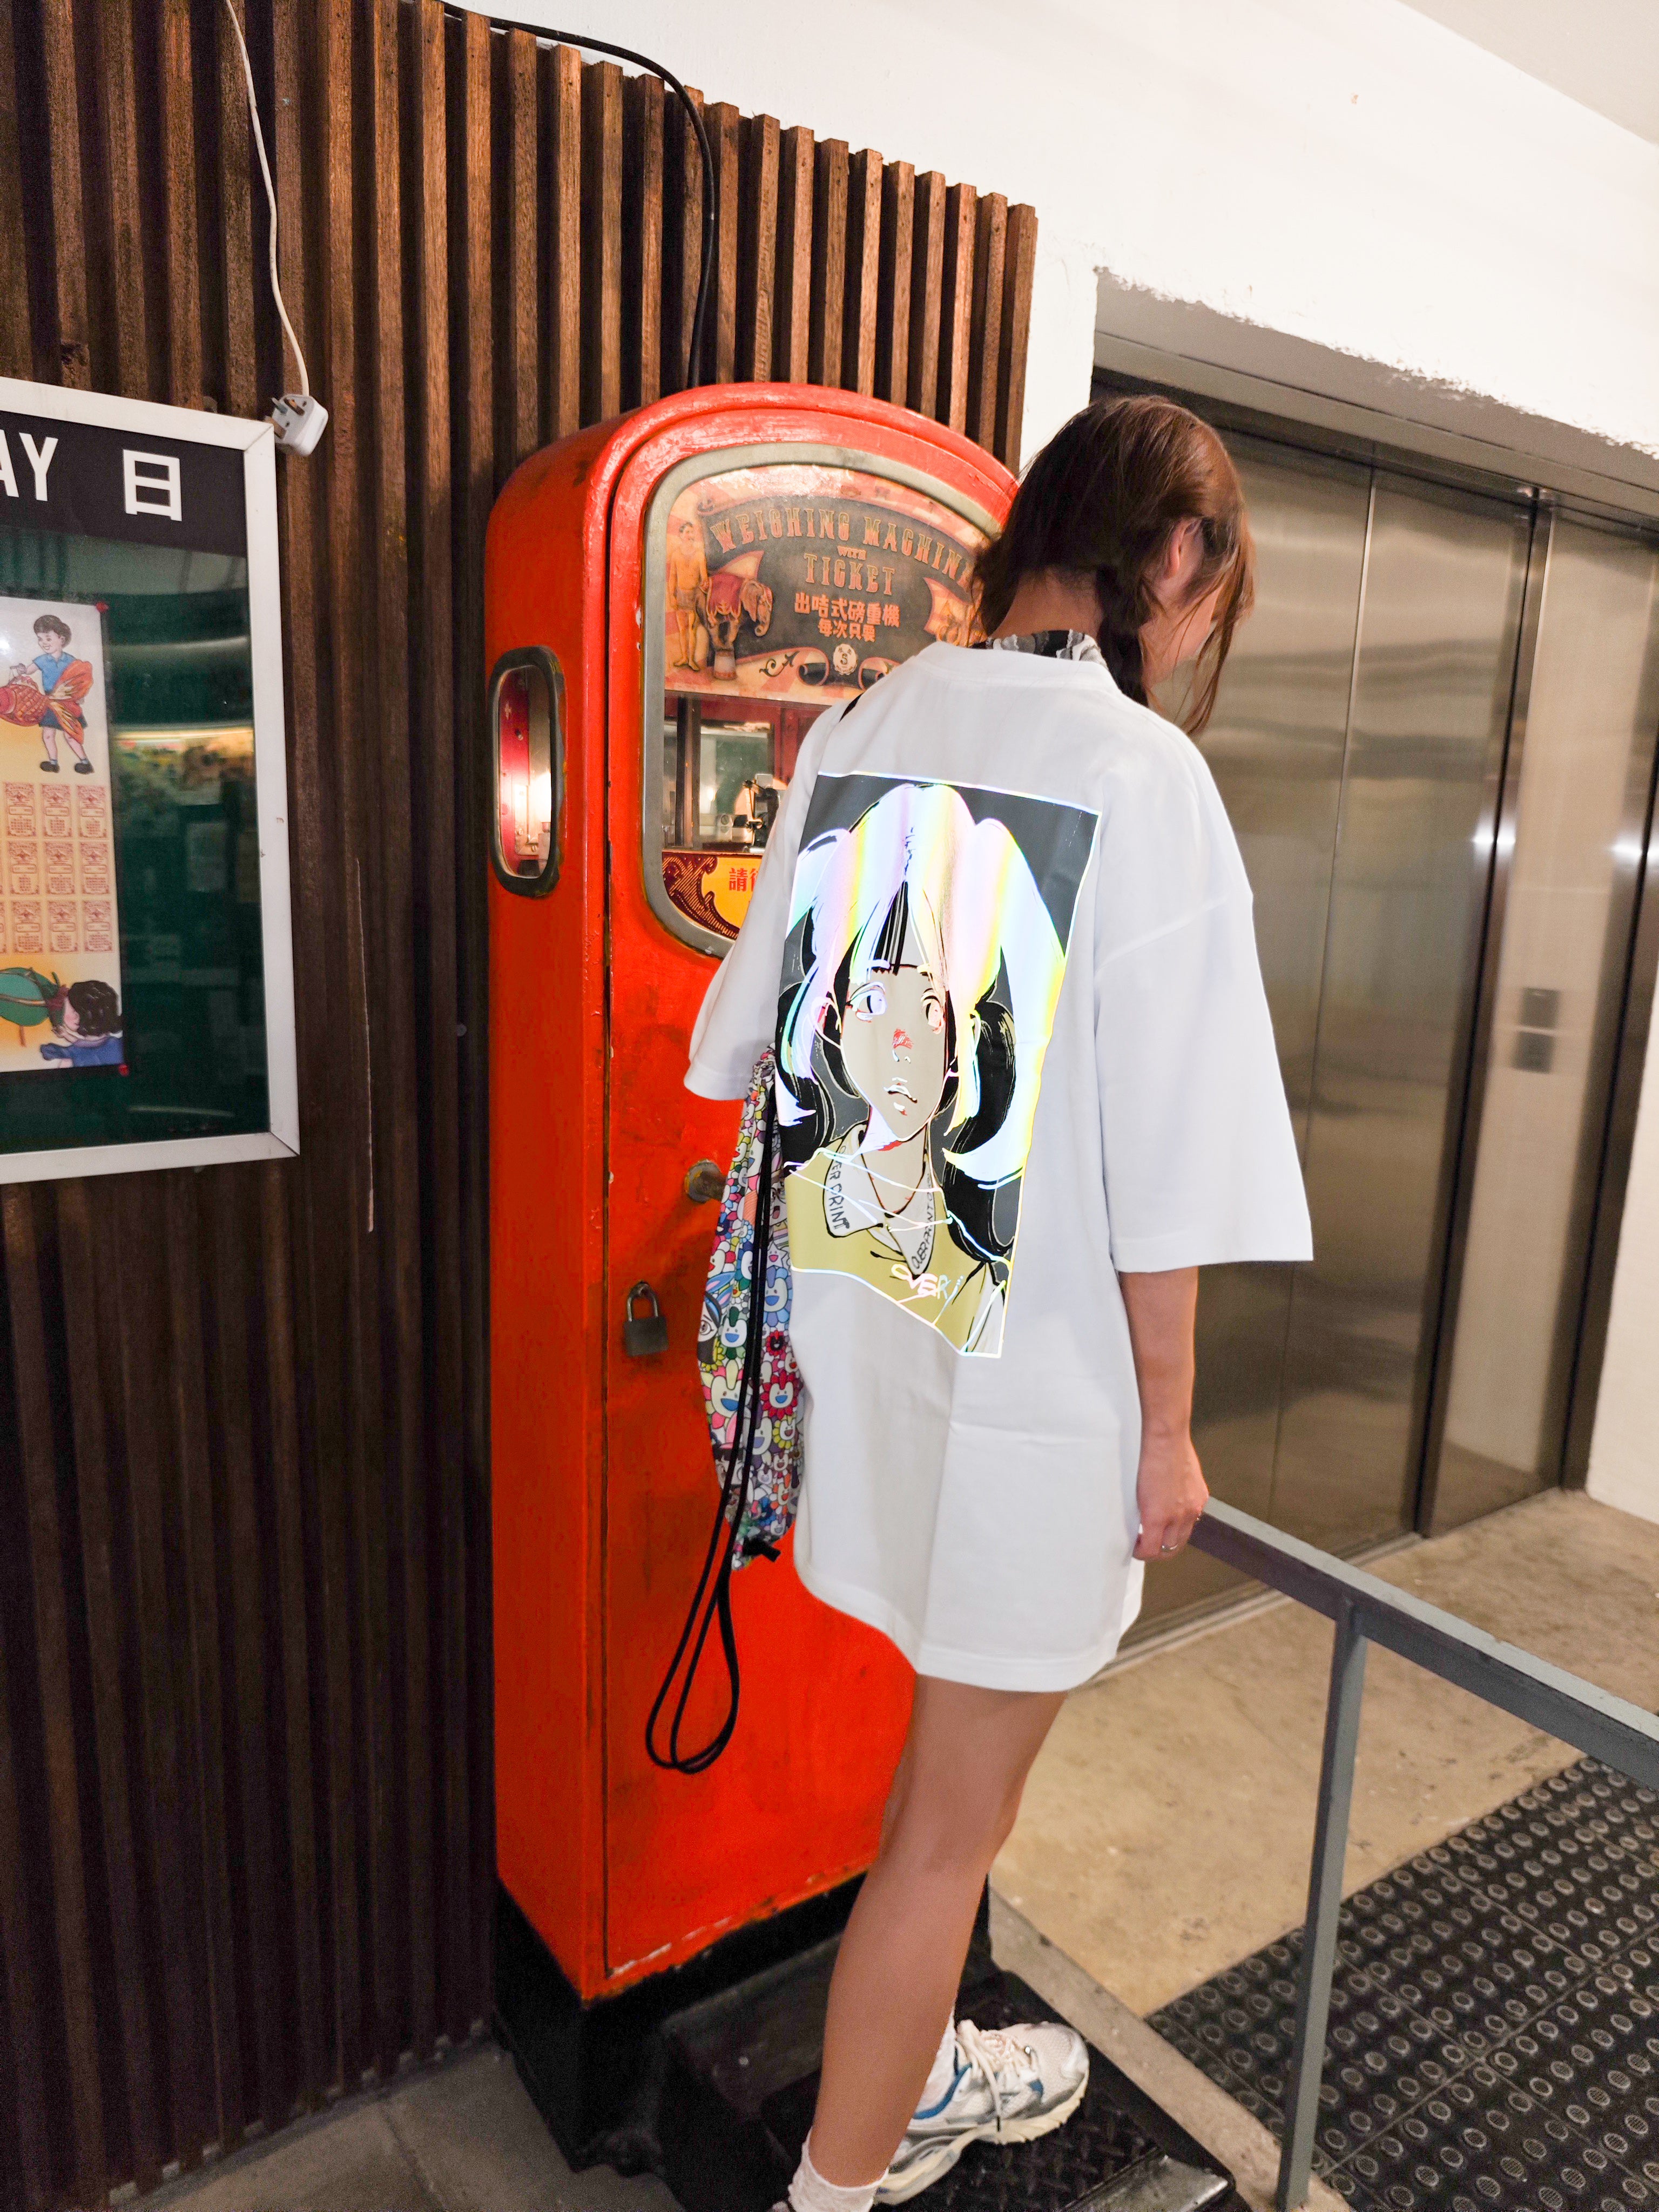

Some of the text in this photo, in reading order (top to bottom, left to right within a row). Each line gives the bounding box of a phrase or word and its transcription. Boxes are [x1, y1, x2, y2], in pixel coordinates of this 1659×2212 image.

[123, 449, 183, 522] 日
[710, 507, 850, 554] WEIGHING
[837, 545, 867, 561] WITH
[804, 553, 895, 596] TICKET
[794, 591, 900, 628] 出咭式磅重機
[818, 617, 876, 643] 每次只要
